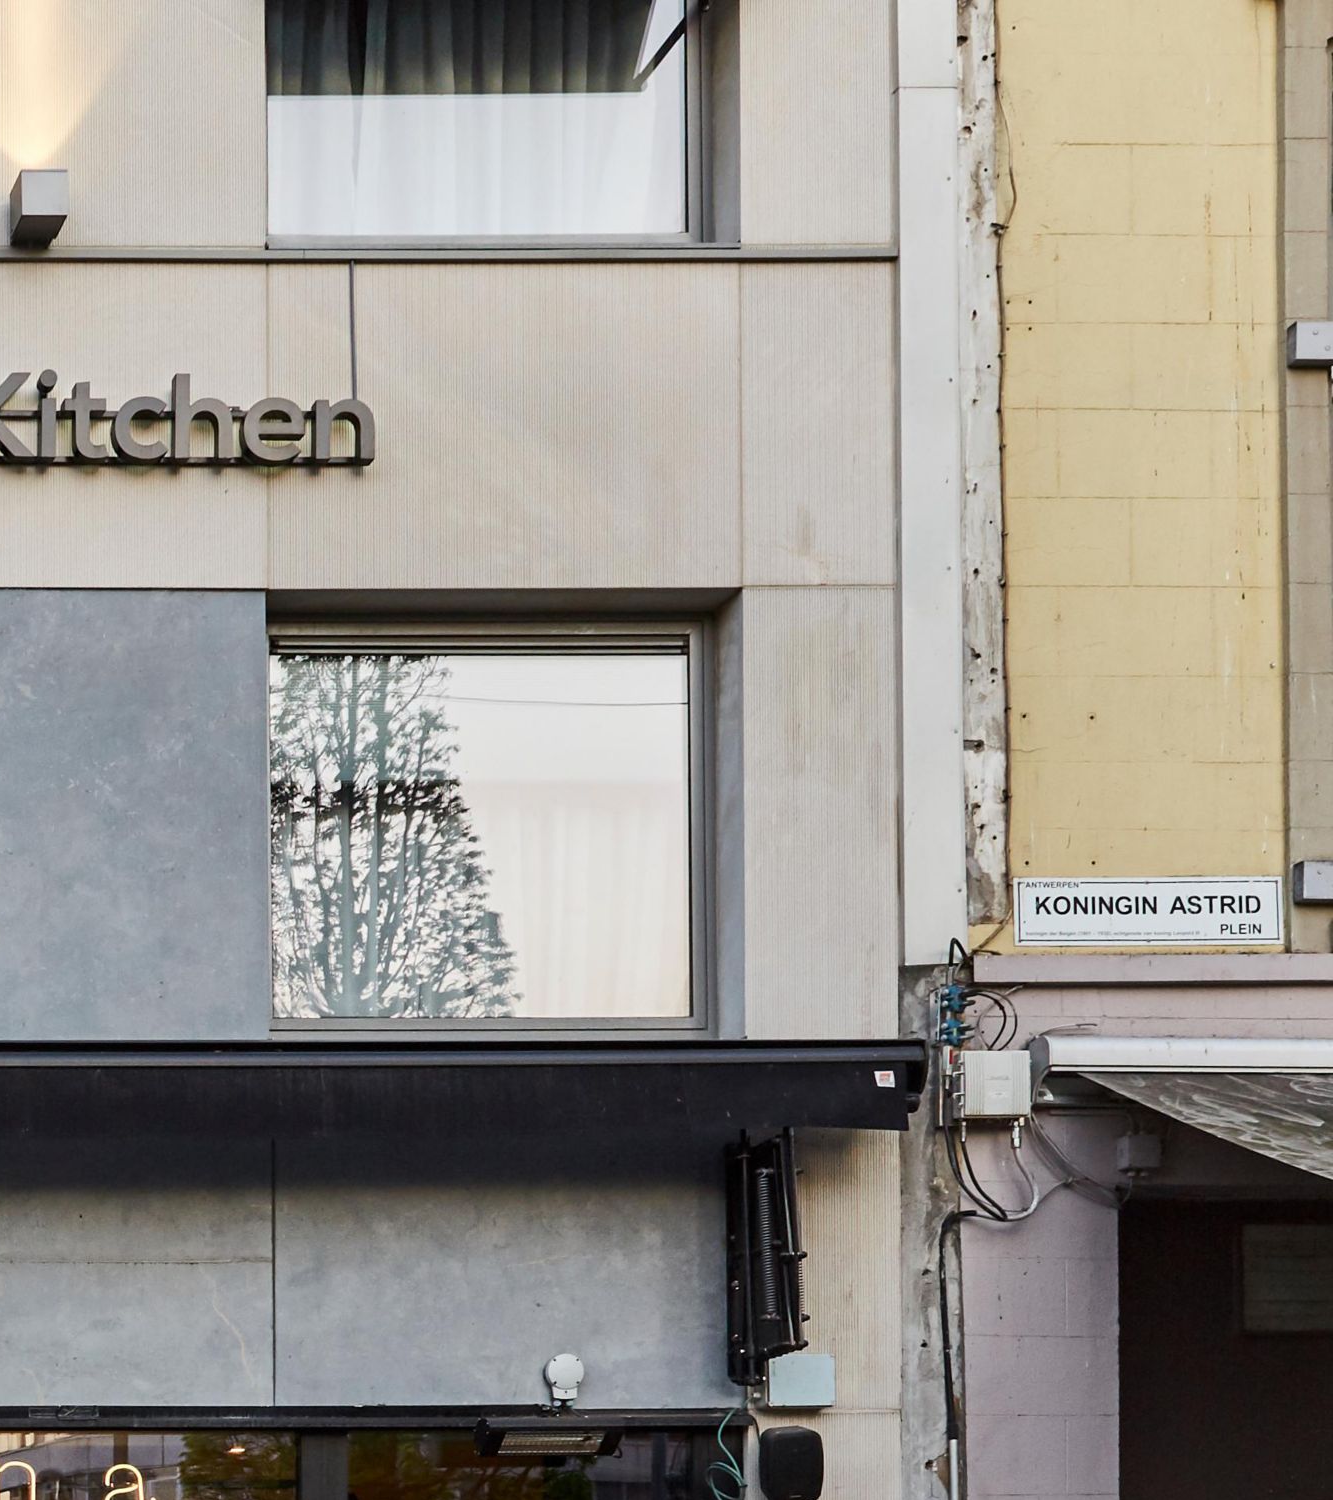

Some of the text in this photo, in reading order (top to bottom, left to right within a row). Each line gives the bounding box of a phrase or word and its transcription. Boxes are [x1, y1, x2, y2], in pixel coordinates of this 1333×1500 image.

[1025, 881, 1080, 889] ANTWERPEN
[1035, 895, 1261, 916] KONINGIN ASTRID
[1220, 923, 1263, 935] PLEIN
